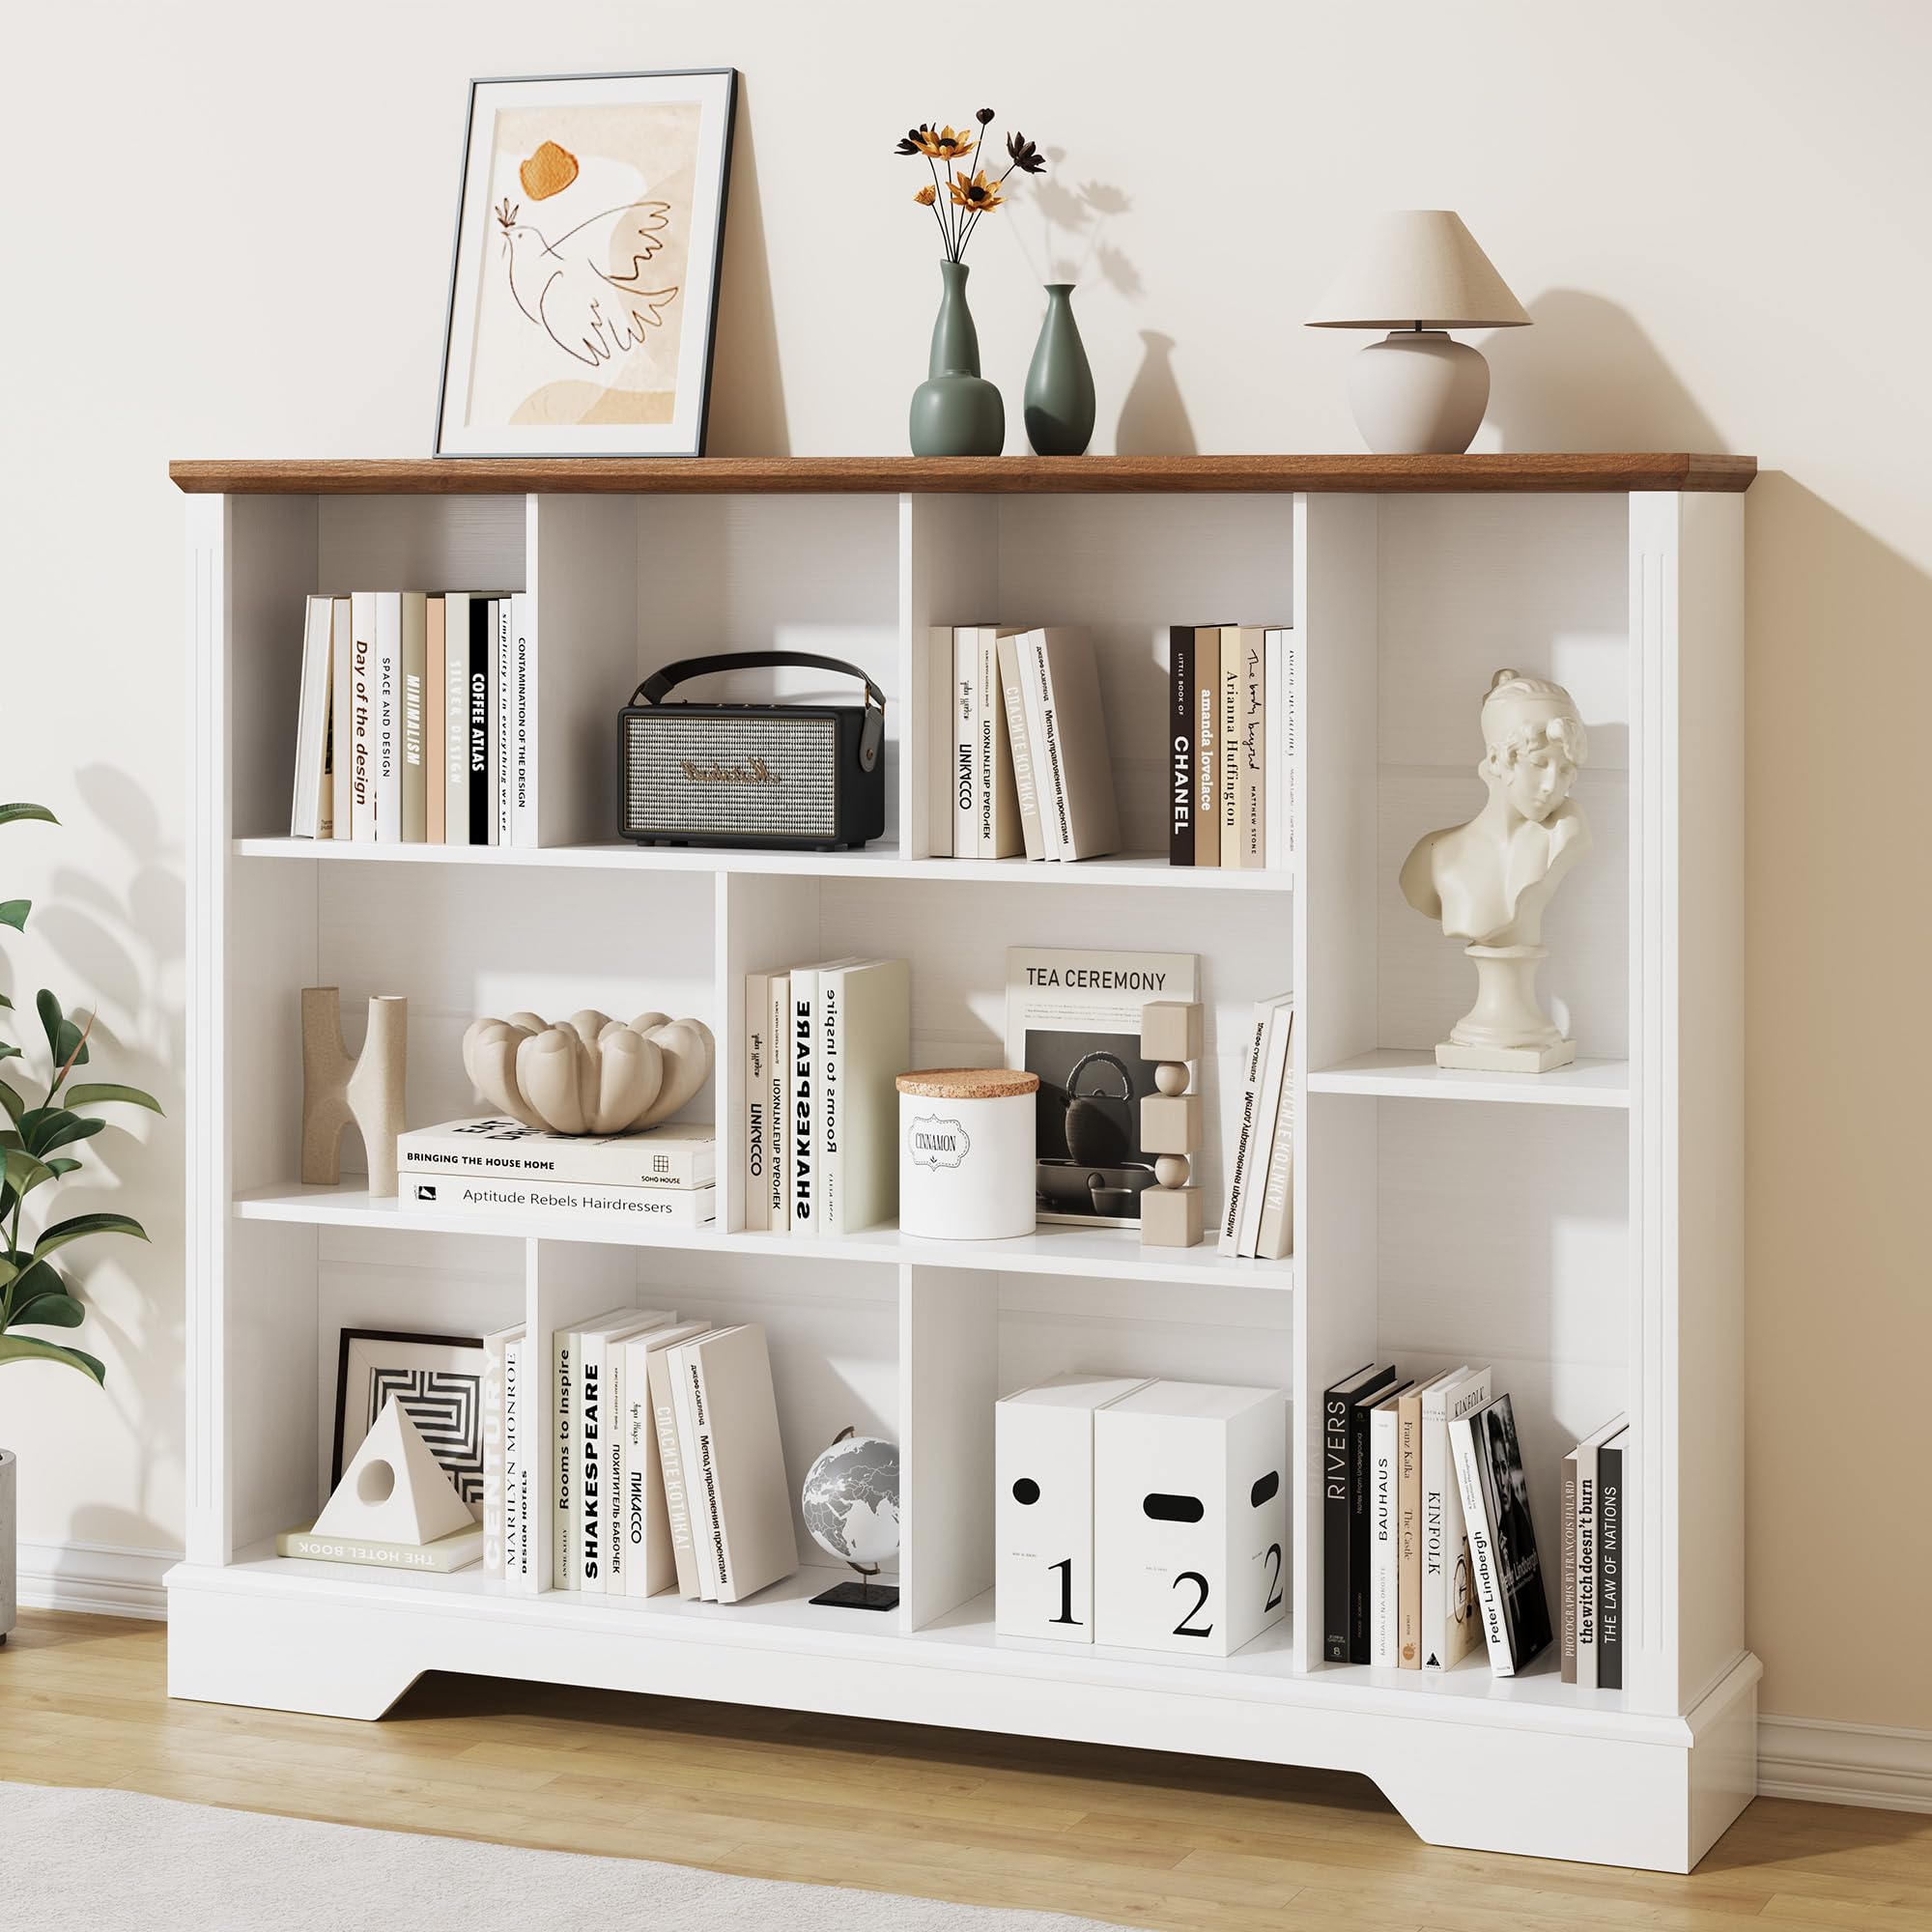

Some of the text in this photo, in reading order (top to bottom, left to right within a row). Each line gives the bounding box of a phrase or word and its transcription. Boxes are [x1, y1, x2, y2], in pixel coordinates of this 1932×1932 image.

[502, 682, 507, 694] is
[1247, 649, 1260, 679] The
[354, 640, 368, 805] Day of the design
[382, 657, 391, 778] SPACE AND DESIGN
[407, 673, 420, 765] MINIMALISM
[449, 660, 462, 784] SILVER DESIGN
[471, 672, 485, 772] COFFEE ATLAS
[502, 698, 507, 711] in
[518, 637, 526, 809] CONTAMINATION OF THE DESIGN
[1178, 705, 1183, 716] OF
[1044, 709, 1054, 740] Метод
[1057, 796, 1069, 845] проектами
[1201, 689, 1213, 811] amanda lovelace
[1223, 670, 1238, 827] Arianna Huffington
[502, 788, 507, 806] we
[1174, 735, 1189, 835] CHANEL
[1026, 967, 1167, 991] TEA CEREMONY
[407, 1152, 555, 1170] BRINGING THE HOUSE HOME
[453, 1120, 515, 1134] EAT
[485, 1126, 547, 1141] DRI
[915, 1132, 956, 1152] CINNAMON
[463, 1188, 672, 1214] Aptitude Rebels Hairdressers
[660, 1177, 681, 1185] HOUSE
[559, 1349, 572, 1510] Rooms to Inspire
[1454, 1385, 1485, 1417] KINFOLK
[507, 1352, 516, 1566] MARILYN MONROE
[584, 1364, 598, 1579] SHAKESPEARE
[1327, 1401, 1346, 1500] RIVERS
[631, 1472, 641, 1544] ПИКАССО
[700, 1435, 710, 1468] Метод
[714, 1530, 727, 1584] проектами
[1378, 1458, 1388, 1541] BAUHAUS
[1578, 1479, 1593, 1515] burn
[299, 1542, 436, 1566] THE HOTEL BOOK
[1405, 1509, 1413, 1560] The Castle
[1428, 1492, 1440, 1576] KINFOLK
[1565, 1480, 1577, 1657] PHOTOGRAPHS BY FRANÇOIS HALARD
[1604, 1486, 1616, 1643] THE LAW OF NATIONS
[1048, 1558, 1084, 1625] 1
[1172, 1571, 1213, 1638] 2
[1264, 1543, 1284, 1613] 2
[1474, 1530, 1500, 1643] Peter Lindbergh
[1578, 1576, 1593, 1617] witch
[1578, 1620, 1593, 1644] the
